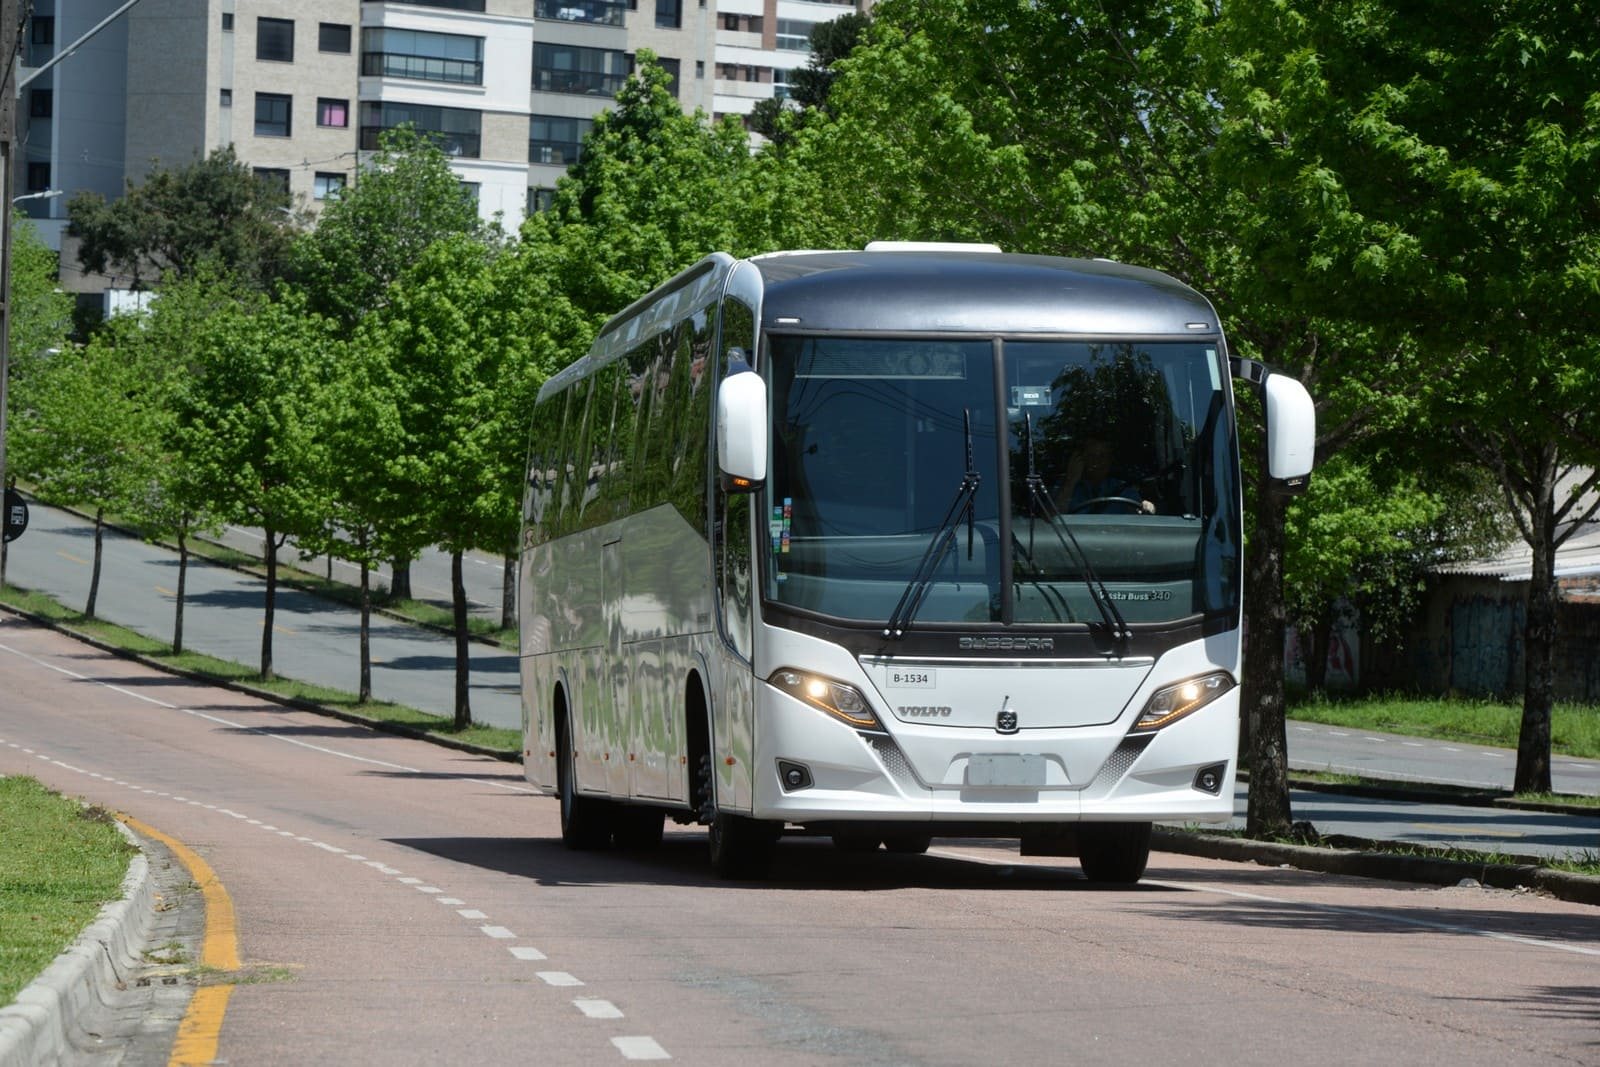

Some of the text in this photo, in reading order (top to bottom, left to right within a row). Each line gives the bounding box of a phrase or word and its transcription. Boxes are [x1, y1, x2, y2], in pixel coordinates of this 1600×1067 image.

[1128, 592, 1149, 600] Buss
[1151, 591, 1171, 600] 340
[959, 637, 1054, 650] BUSSCAR
[893, 673, 929, 684] B-1534
[898, 706, 953, 718] VOLVO
